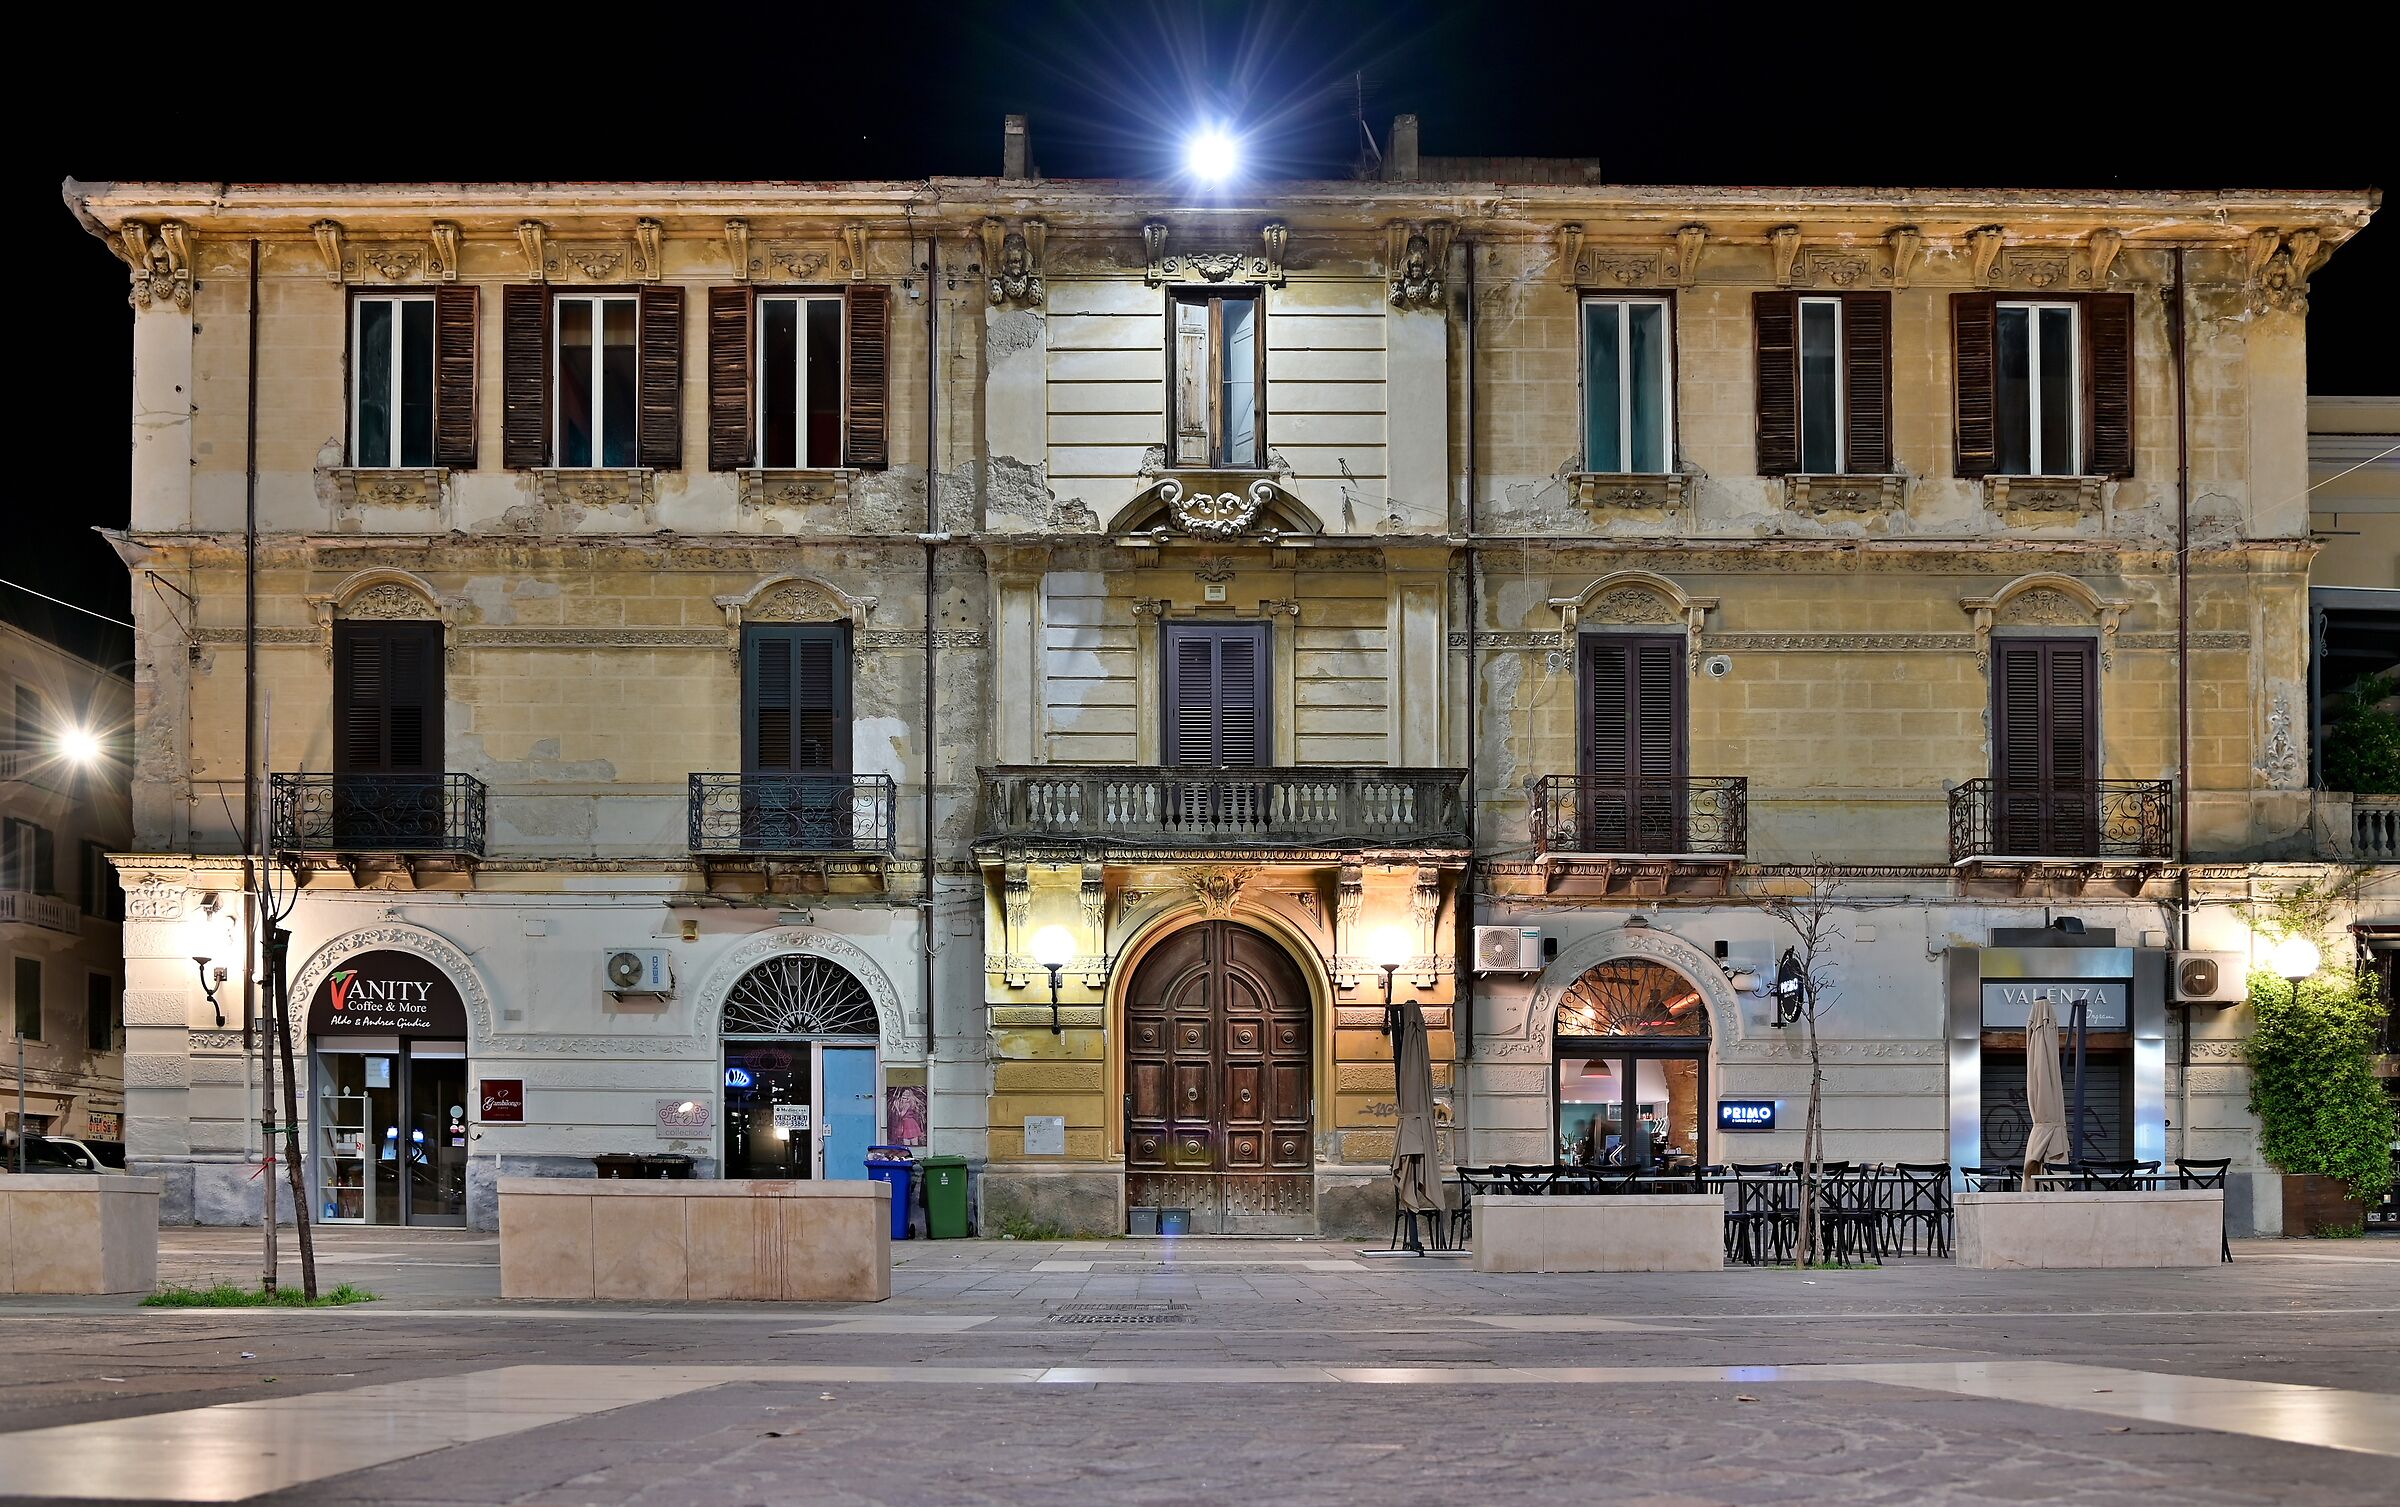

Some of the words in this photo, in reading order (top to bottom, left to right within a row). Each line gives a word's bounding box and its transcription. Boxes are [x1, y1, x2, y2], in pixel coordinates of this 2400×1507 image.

[329, 969, 434, 1010] VANITY
[347, 1000, 384, 1012] Coffee
[385, 1002, 396, 1012] &
[398, 1003, 428, 1013] More
[330, 1015, 352, 1026] Aldo
[362, 1016, 395, 1027] Andrea
[396, 1018, 432, 1029] Giudice
[1723, 1107, 1771, 1119] PRIMO
